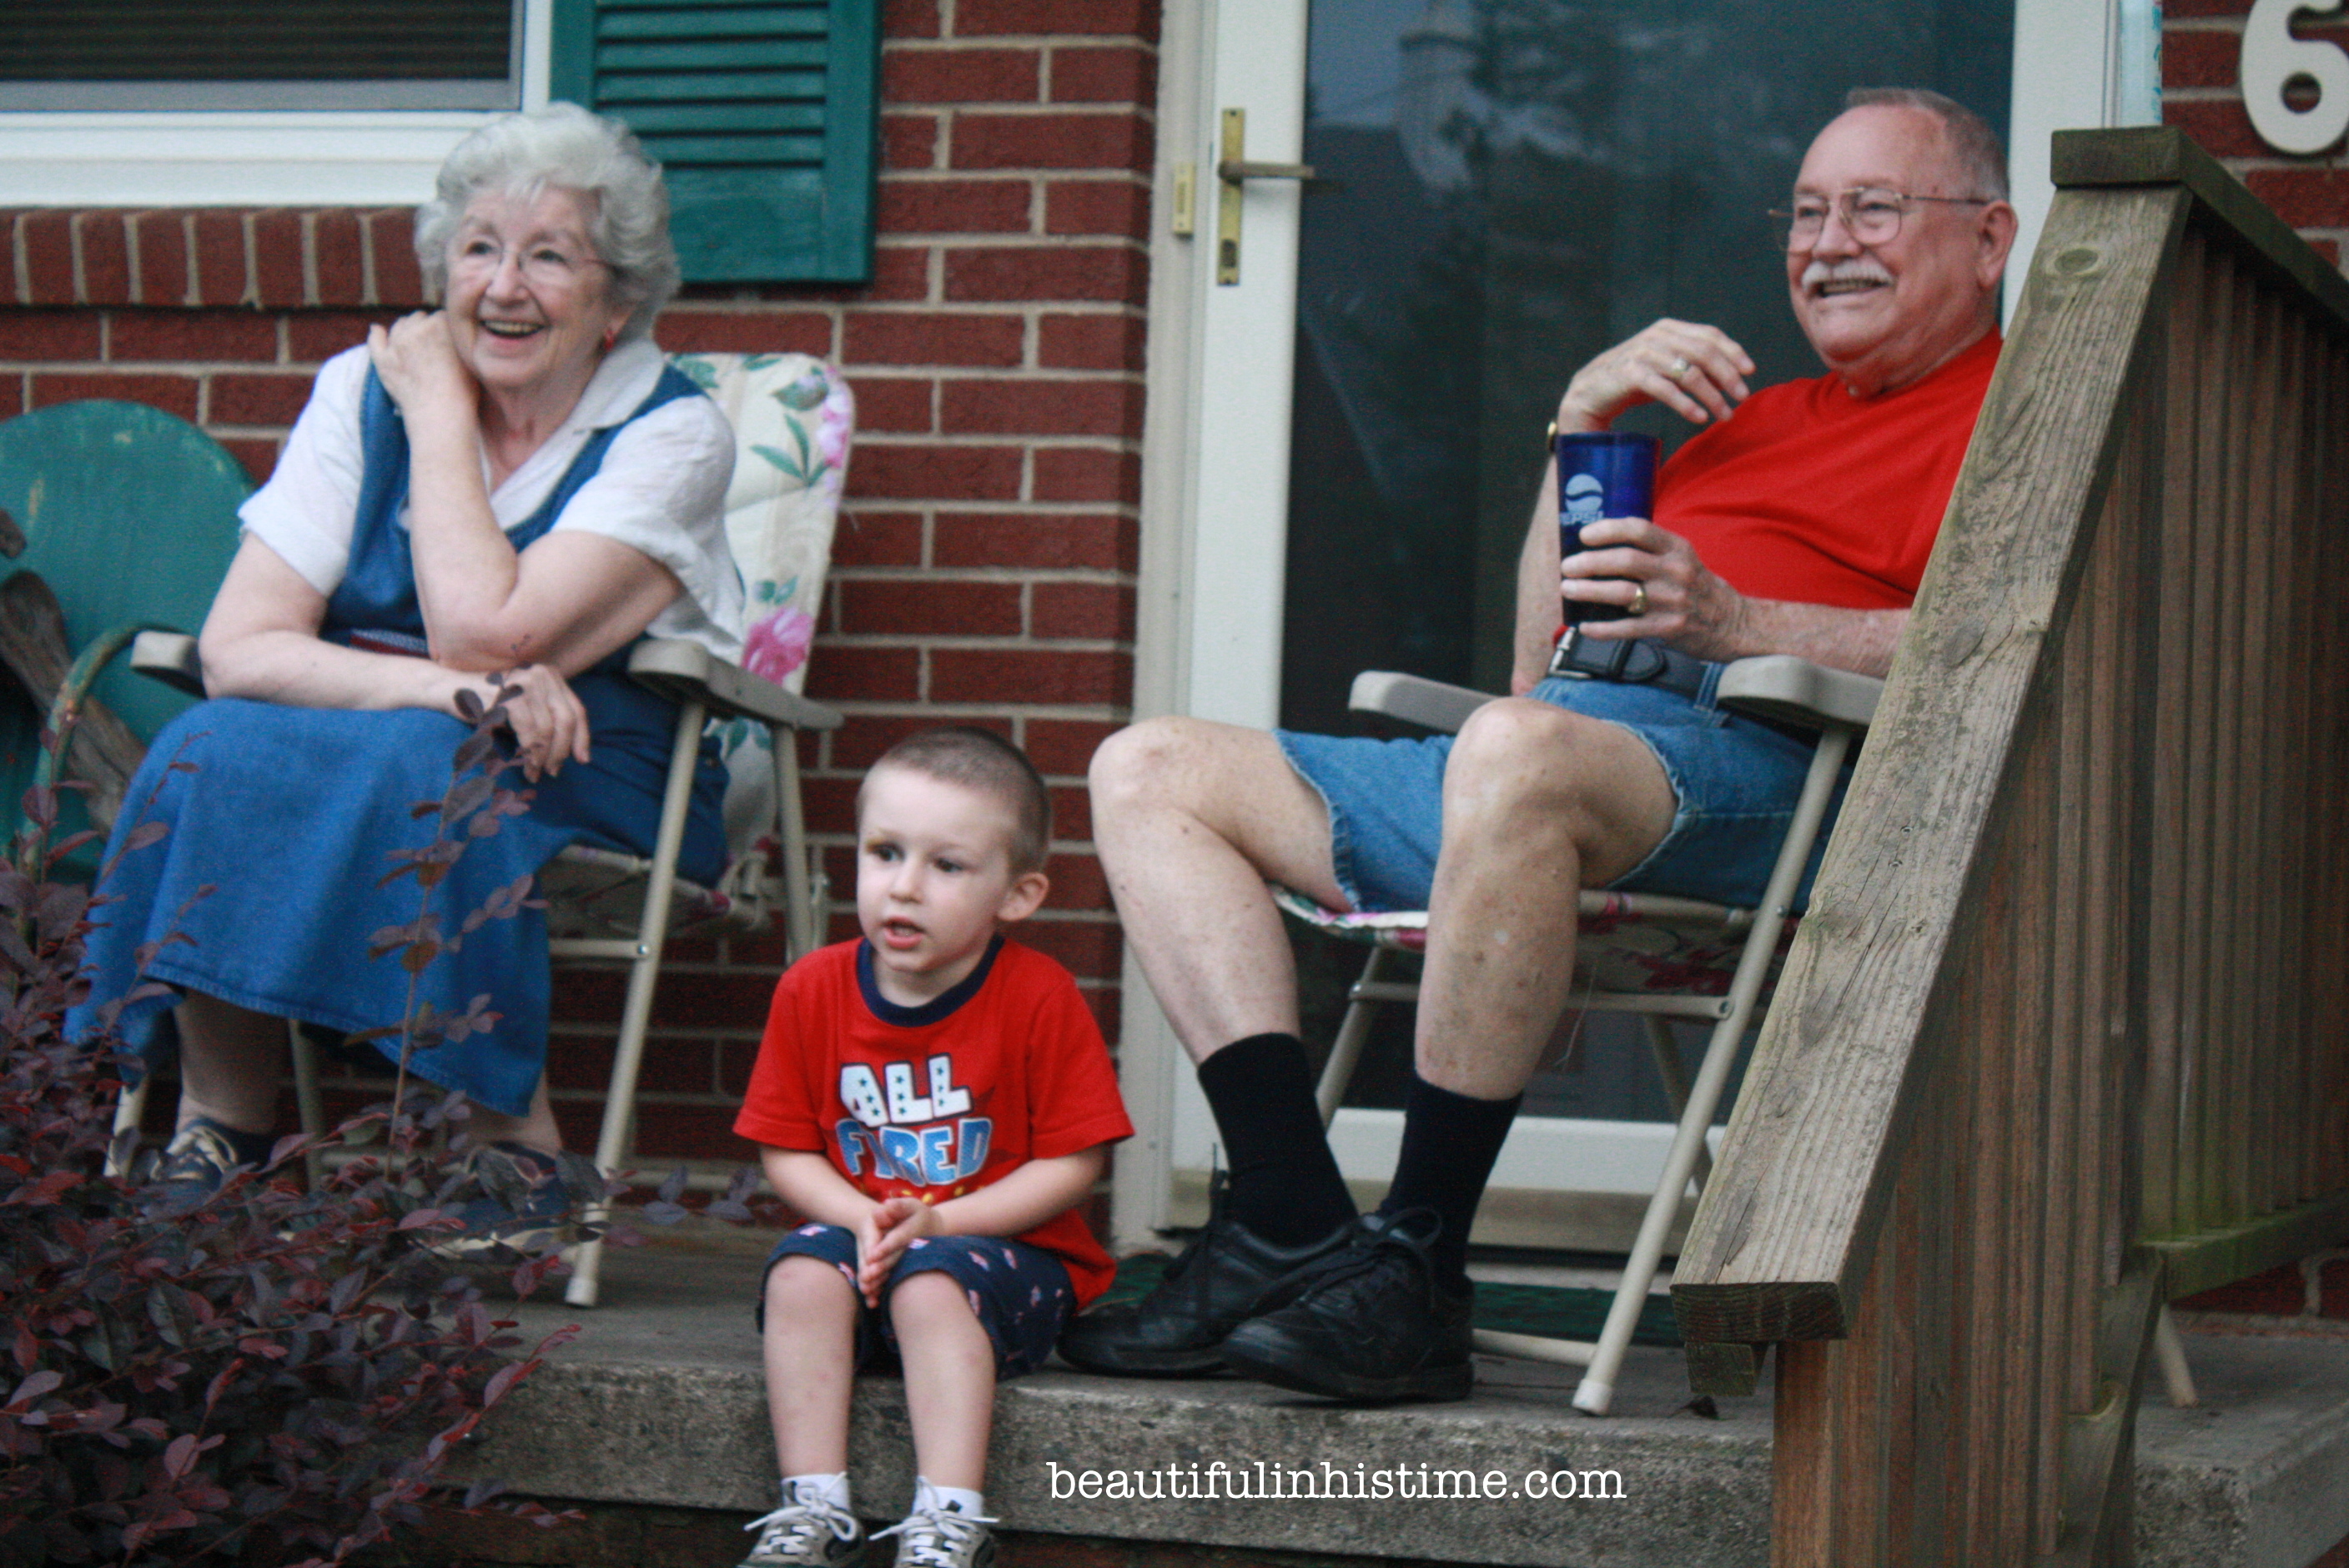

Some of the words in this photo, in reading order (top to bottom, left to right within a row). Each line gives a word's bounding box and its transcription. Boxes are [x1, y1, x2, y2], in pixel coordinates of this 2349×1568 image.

[2241, 0, 2349, 153] 6
[840, 1053, 973, 1129] ALL
[836, 1118, 993, 1187] FIRED
